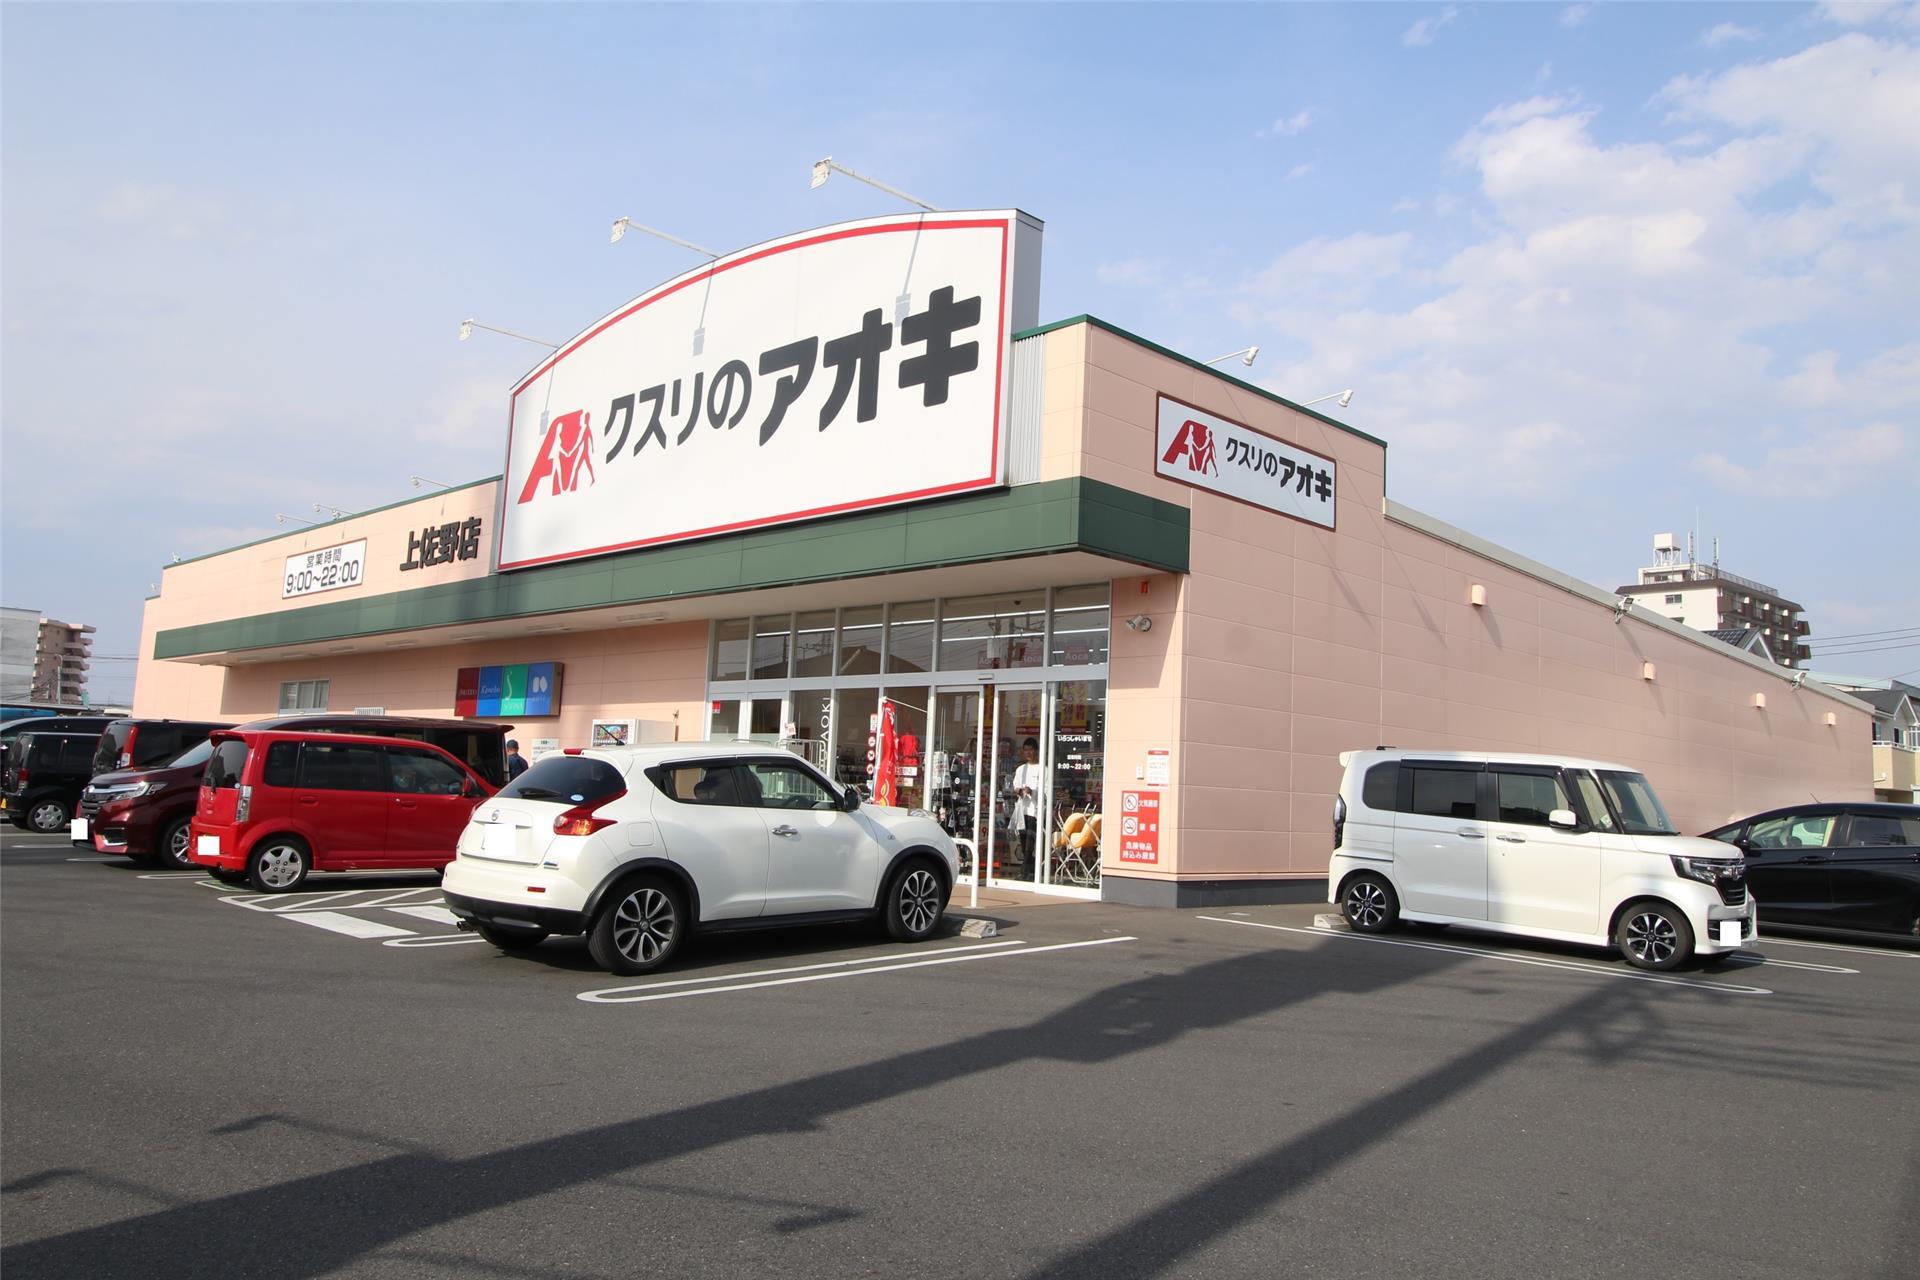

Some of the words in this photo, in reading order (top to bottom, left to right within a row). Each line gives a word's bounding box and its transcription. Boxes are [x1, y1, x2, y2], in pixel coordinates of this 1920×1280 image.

[604, 285, 982, 464] クスリのアオキ
[1226, 437, 1332, 502] クスリのアオキ
[306, 548, 343, 568] 営業時間
[400, 516, 482, 571] 上佐野店
[820, 697, 831, 741] AOKI
